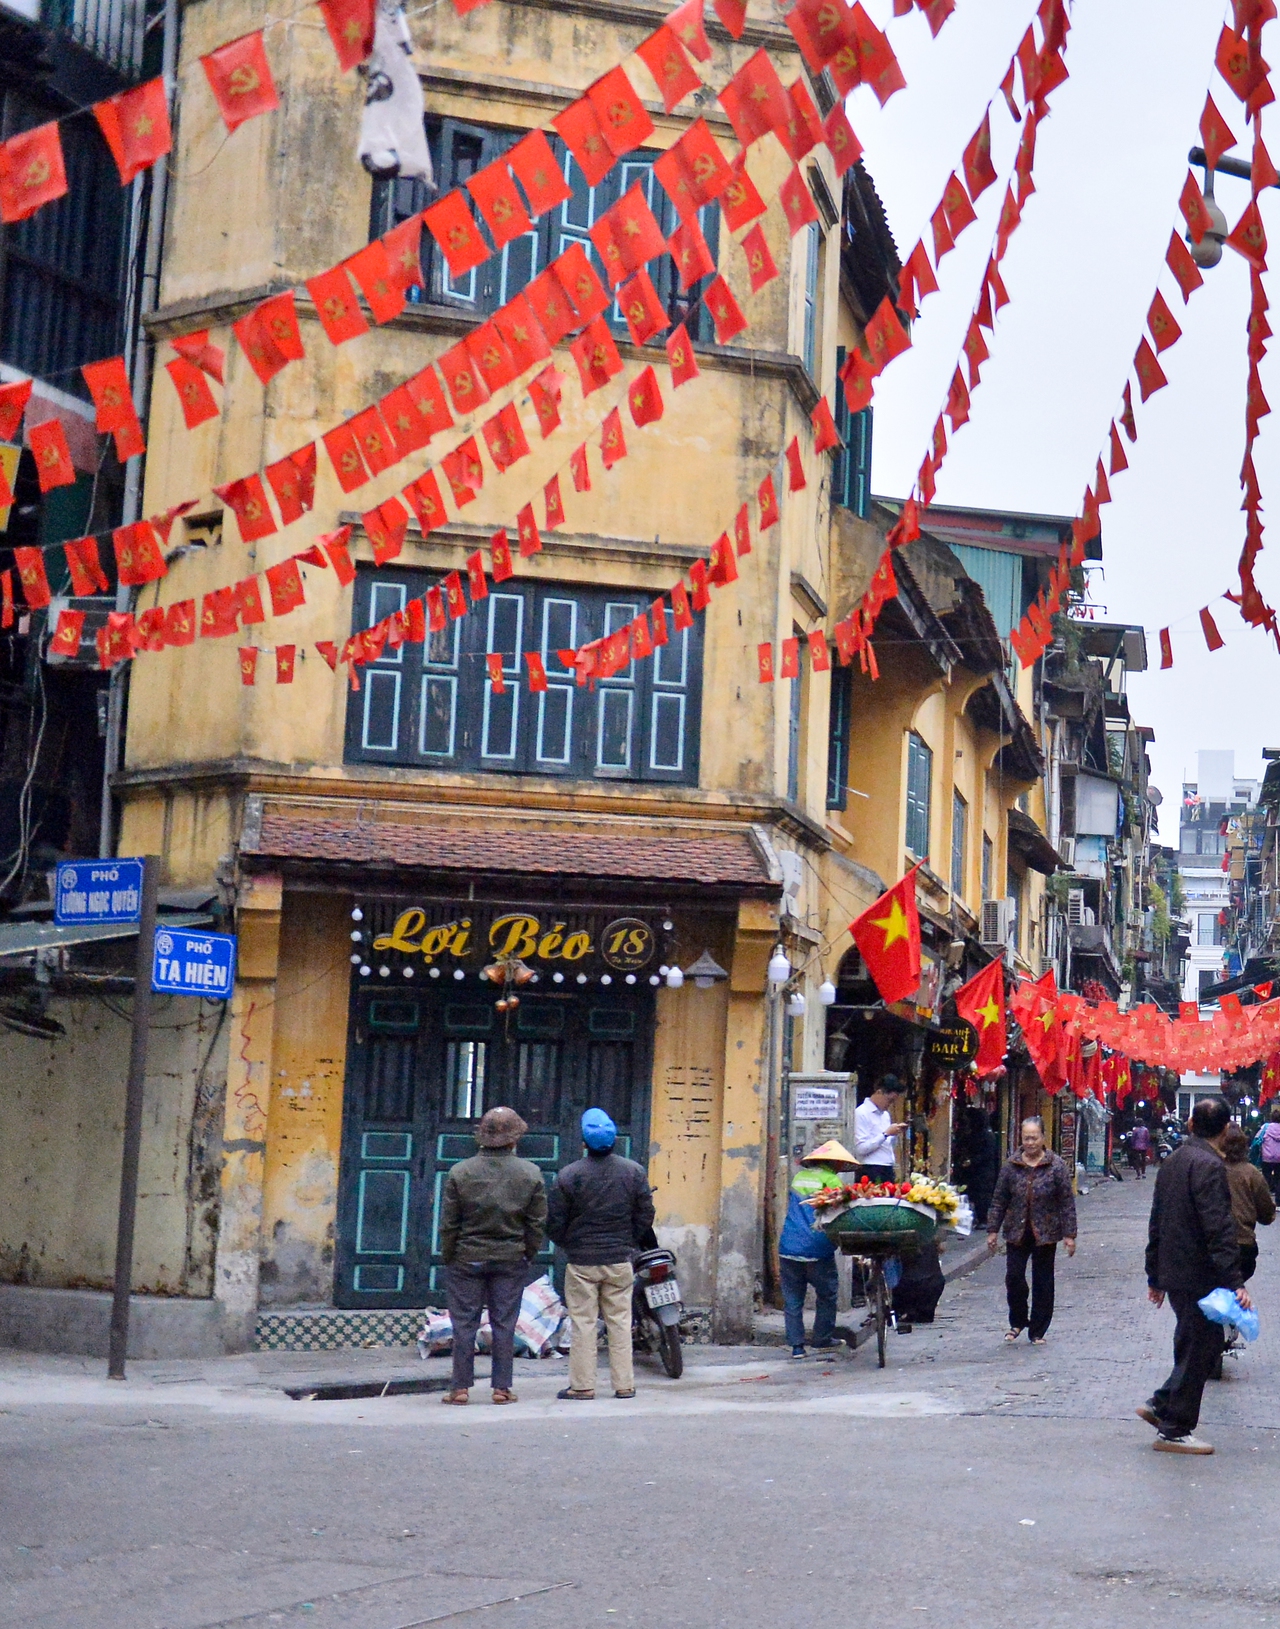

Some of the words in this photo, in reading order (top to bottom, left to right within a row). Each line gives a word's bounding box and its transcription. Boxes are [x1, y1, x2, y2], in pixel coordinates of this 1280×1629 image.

[91, 865, 119, 882] PHỐ
[373, 906, 472, 964] Lợi
[489, 913, 594, 960] Béo
[608, 928, 649, 955] 18
[186, 939, 214, 955] PHỐ
[158, 959, 181, 986] TẠ
[185, 959, 227, 990] HIỆN
[932, 1043, 959, 1054] BAR
